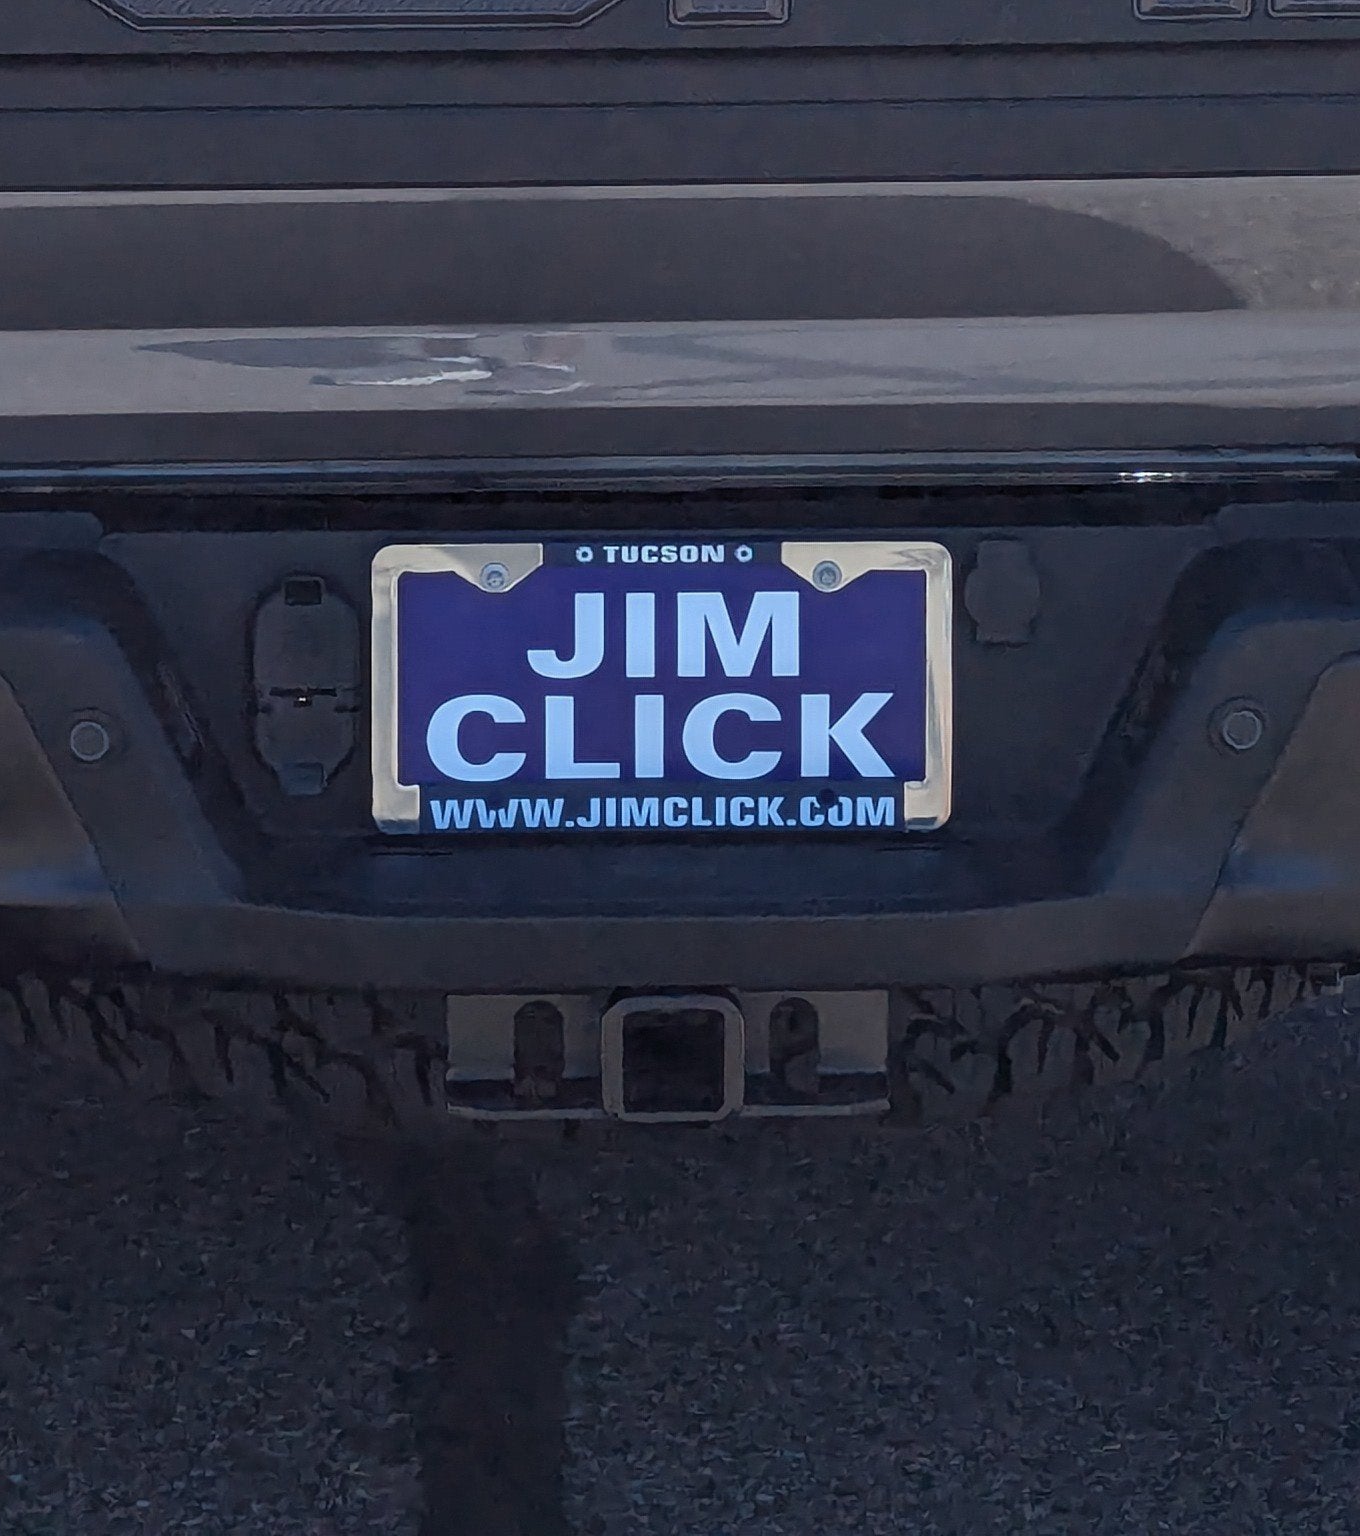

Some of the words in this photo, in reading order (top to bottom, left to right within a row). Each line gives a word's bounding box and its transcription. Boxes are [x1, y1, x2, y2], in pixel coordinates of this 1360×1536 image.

[603, 545, 725, 563] TUCSON
[526, 590, 800, 679] JIM
[426, 692, 895, 782] CLICK
[430, 796, 895, 830] WWW.JIMCLICK.COM
